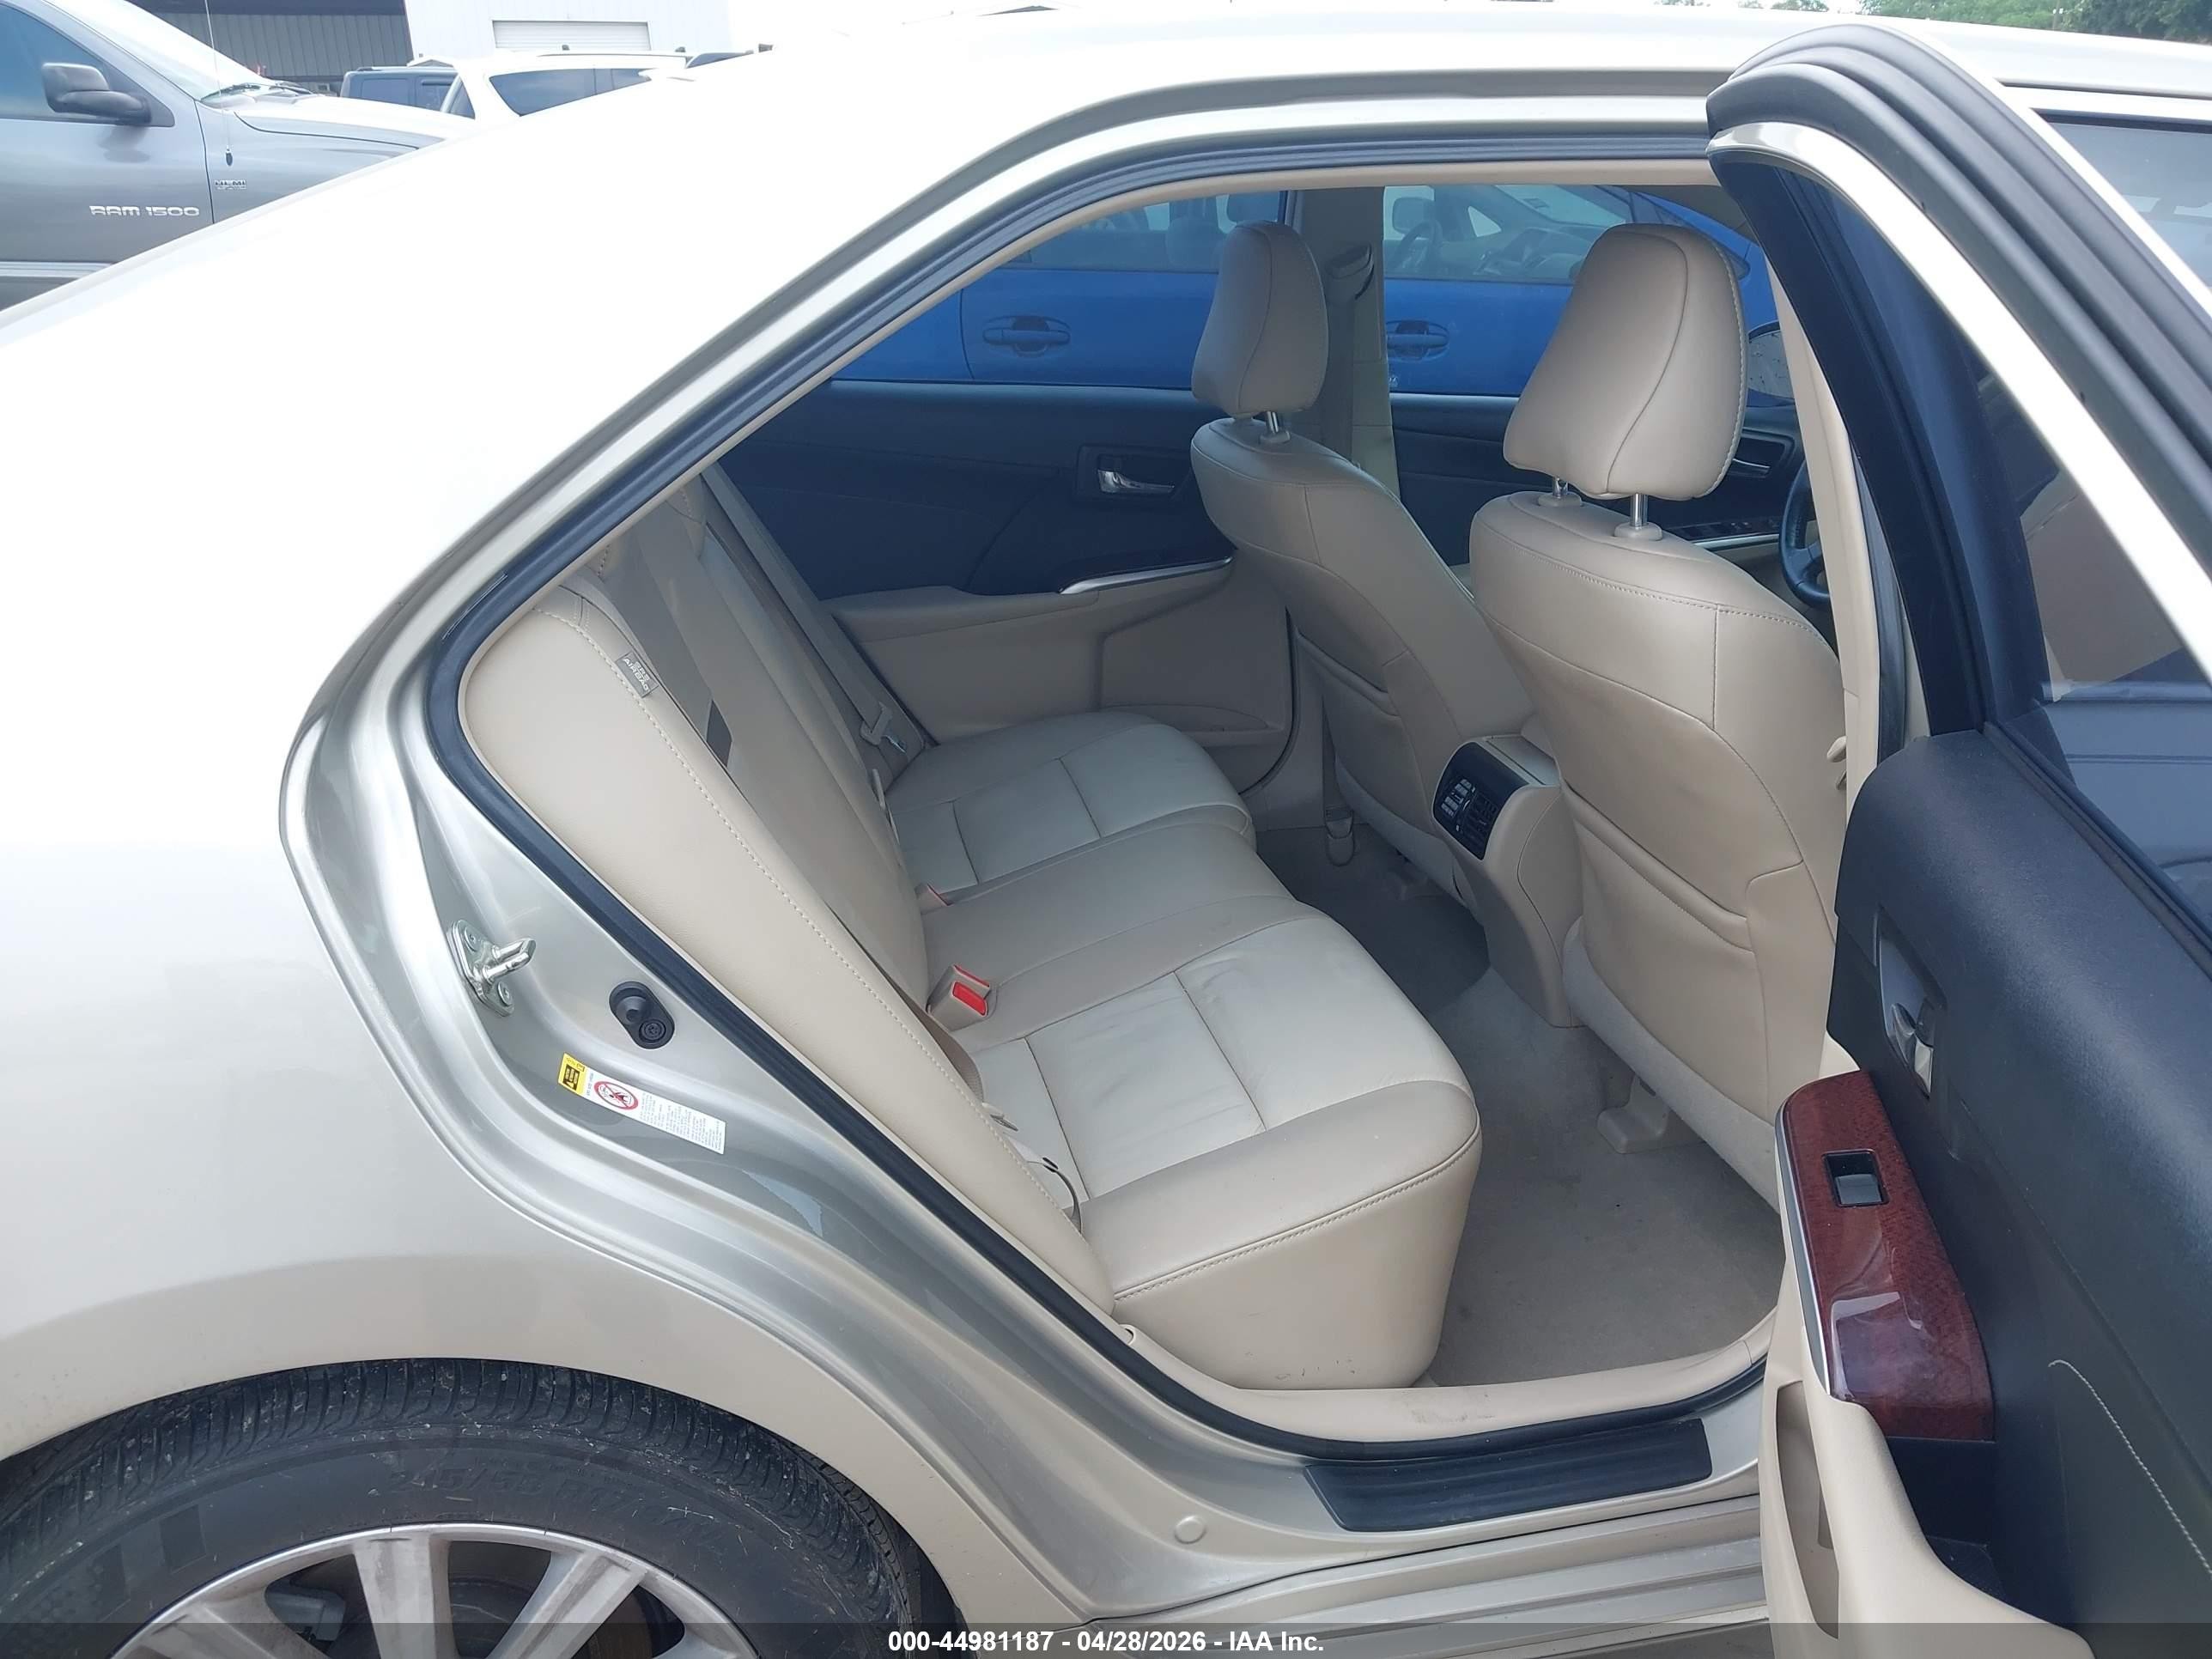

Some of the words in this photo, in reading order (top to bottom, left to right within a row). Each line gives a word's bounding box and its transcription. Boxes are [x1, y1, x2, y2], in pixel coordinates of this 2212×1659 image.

[89, 205, 140, 216] RAM
[145, 206, 200, 216] 1500
[623, 659, 649, 691] AIRBAG
